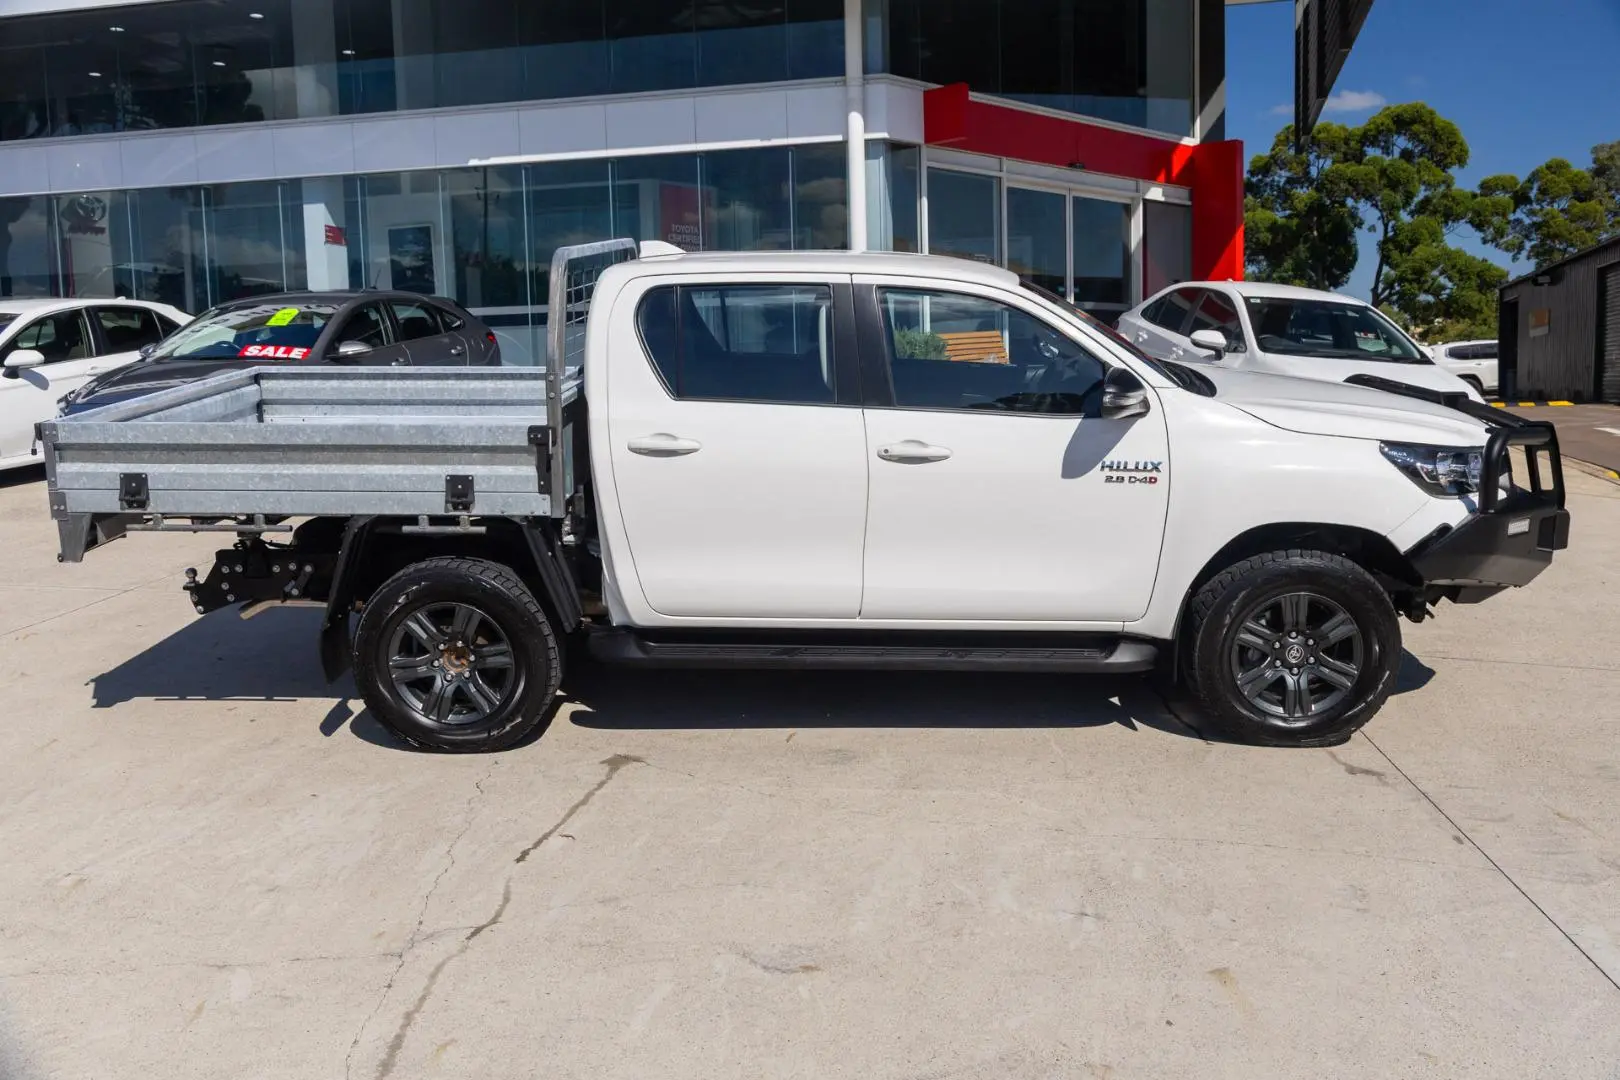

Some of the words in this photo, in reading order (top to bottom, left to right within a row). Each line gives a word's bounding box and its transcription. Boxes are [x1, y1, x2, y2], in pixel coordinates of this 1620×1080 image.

[671, 223, 698, 232] TOYOTA
[244, 345, 307, 359] SALE
[1100, 460, 1163, 473] HILUX
[1128, 475, 1158, 484] D-4D
